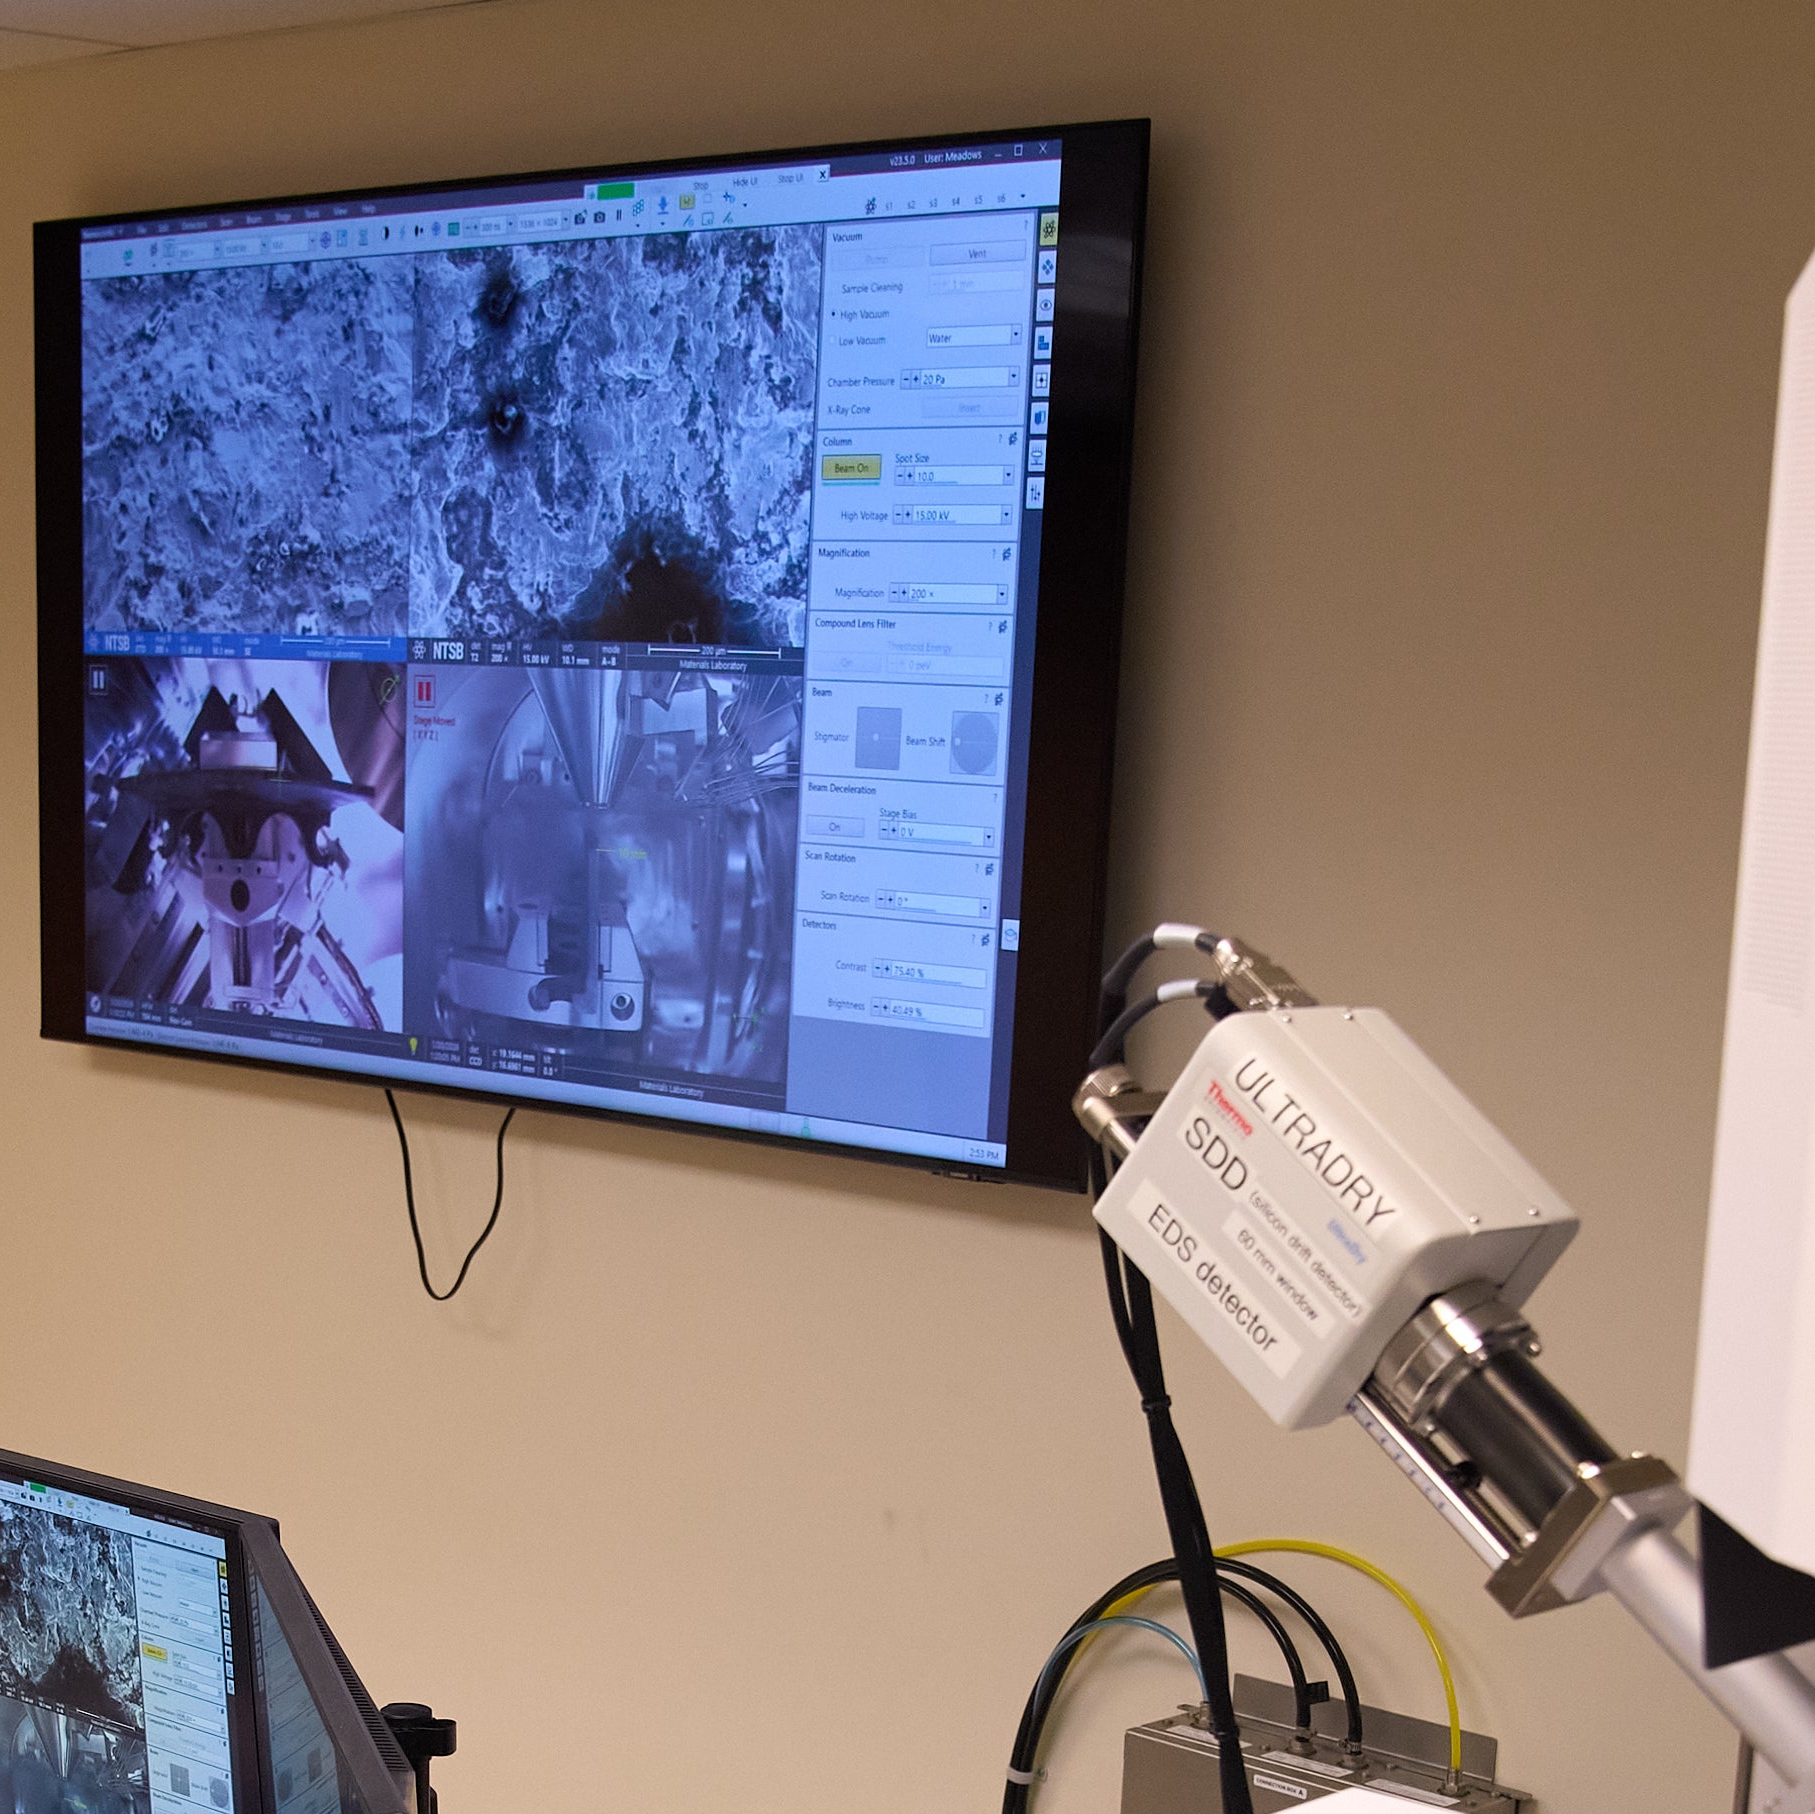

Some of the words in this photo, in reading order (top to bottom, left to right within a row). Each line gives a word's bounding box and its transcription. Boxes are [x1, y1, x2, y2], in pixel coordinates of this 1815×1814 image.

[924, 153, 944, 164] User:
[945, 151, 982, 162] Meadows
[833, 232, 863, 242] Vacuum
[969, 249, 987, 259] Vent
[842, 284, 869, 295] Sample
[870, 282, 903, 294] Cleaning
[840, 310, 858, 321] High
[861, 309, 889, 319] Vacuum
[839, 336, 856, 346] Low
[858, 336, 886, 346] Vacuum
[929, 333, 952, 344] Water
[828, 377, 861, 387] Chamber
[864, 376, 895, 386] Pressure
[923, 375, 934, 385] 20
[936, 374, 945, 385] Pa
[852, 405, 871, 415] Cone
[823, 437, 852, 447] Column
[895, 453, 912, 464] Spot
[915, 453, 930, 463] Size
[835, 463, 854, 473] Beam
[857, 463, 869, 473] On
[841, 511, 859, 522] High
[861, 511, 888, 522] Voltage
[939, 510, 950, 520] kV
[818, 548, 870, 559] Magnification
[835, 588, 884, 598] Magnification
[911, 589, 927, 599] 200
[815, 618, 856, 630] Compound
[858, 619, 875, 629] Lens
[877, 620, 896, 630] Filter
[104, 634, 130, 652] NTSB
[433, 642, 465, 661] NTSB
[679, 659, 709, 670] Materials
[711, 661, 748, 673] Laboratory
[812, 687, 833, 697] Beam
[814, 732, 849, 743] Stigmator
[906, 736, 927, 746] Beam
[929, 736, 946, 747] Shift
[808, 782, 828, 793] Beam
[830, 783, 877, 796] Deceleration
[879, 808, 901, 821] Stage
[903, 809, 917, 820] Bias
[829, 822, 841, 833] On
[805, 851, 823, 861] Scan
[824, 852, 856, 863] Rotation
[839, 892, 870, 903] Rotation
[802, 919, 837, 931] Detectors
[836, 960, 867, 972] Contrast
[1206, 1079, 1254, 1137] Thermo
[1235, 1057, 1397, 1227] ULTRADRY
[1185, 1116, 1248, 1191] SDD
[1147, 1202, 1198, 1264] EDS
[1194, 1260, 1279, 1351] detector
[1237, 1228, 1256, 1251] 60
[1253, 1248, 1277, 1276] mm
[1275, 1273, 1319, 1322] window
[1288, 1232, 1312, 1264] drift
[1310, 1259, 1363, 1319] detector)
